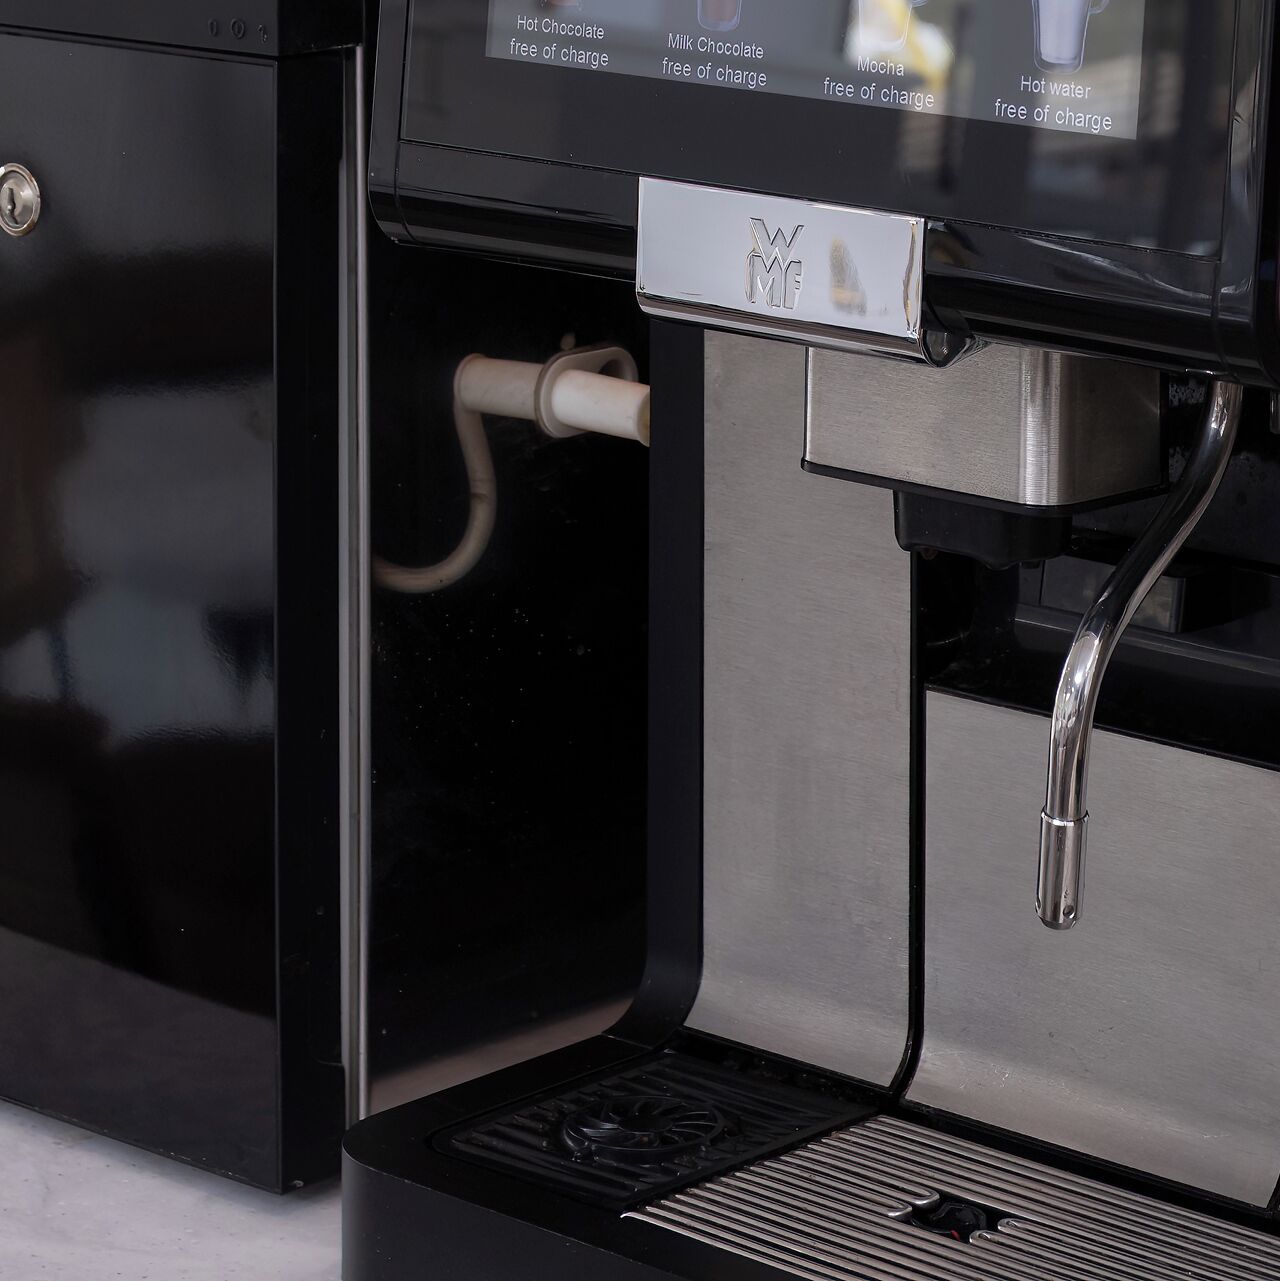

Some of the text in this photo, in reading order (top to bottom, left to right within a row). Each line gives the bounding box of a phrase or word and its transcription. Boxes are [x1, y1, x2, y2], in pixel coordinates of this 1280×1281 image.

[516, 14, 605, 40] Hot Chocolate
[509, 38, 610, 69] free of charge
[667, 32, 764, 59] Milk Chocolate
[661, 57, 768, 90] free of charge
[857, 55, 905, 77] Mocha
[823, 76, 935, 111] free of charge
[1020, 74, 1092, 100] Hot water
[994, 98, 1113, 134] free of charge
